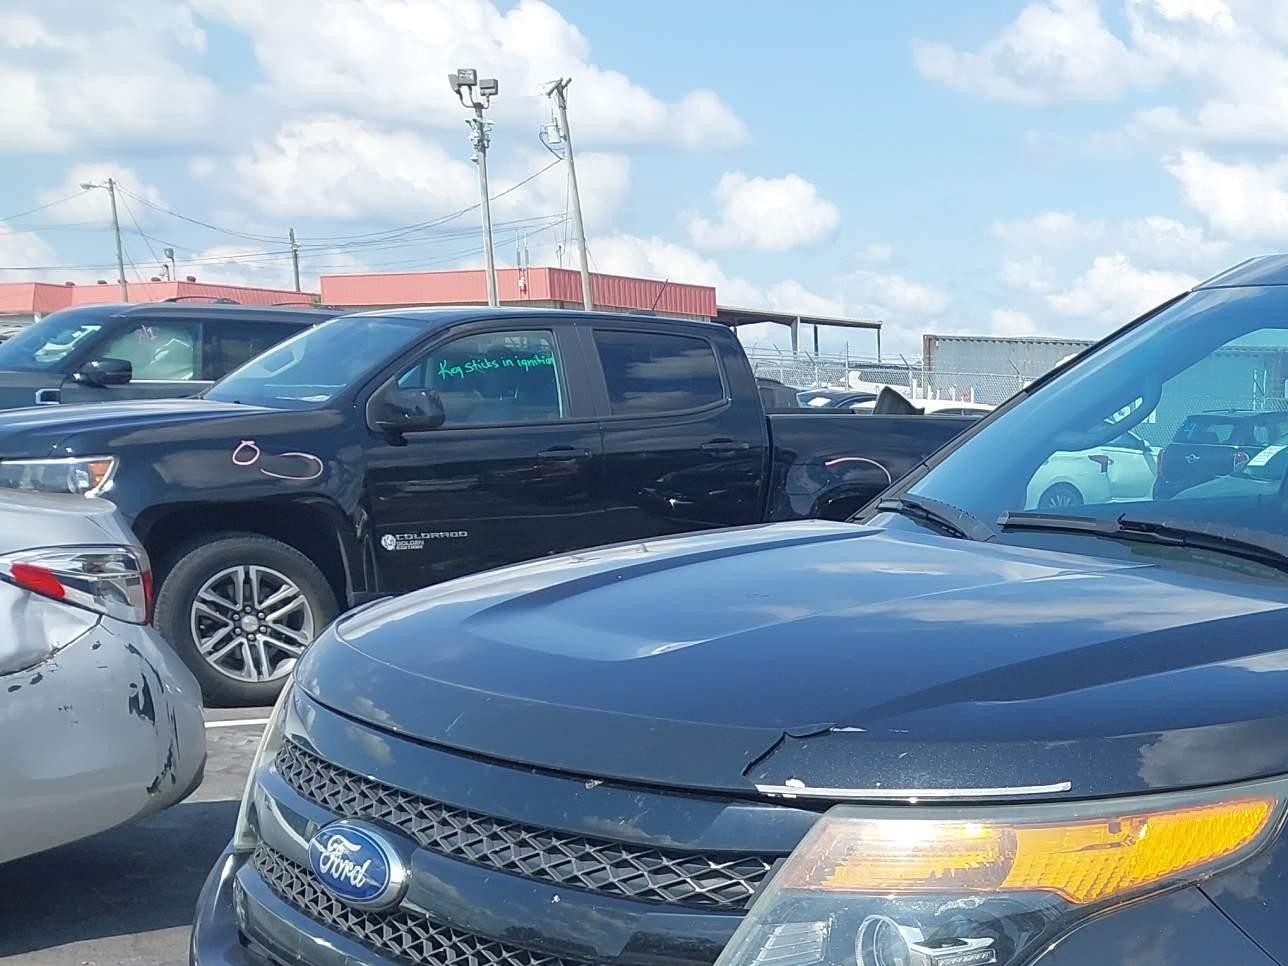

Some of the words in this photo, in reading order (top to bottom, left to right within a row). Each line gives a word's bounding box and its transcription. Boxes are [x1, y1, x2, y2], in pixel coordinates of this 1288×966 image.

[438, 359, 464, 380] Key
[501, 356, 514, 367] in
[396, 531, 468, 541] COLORADO
[317, 834, 373, 888] Ford
